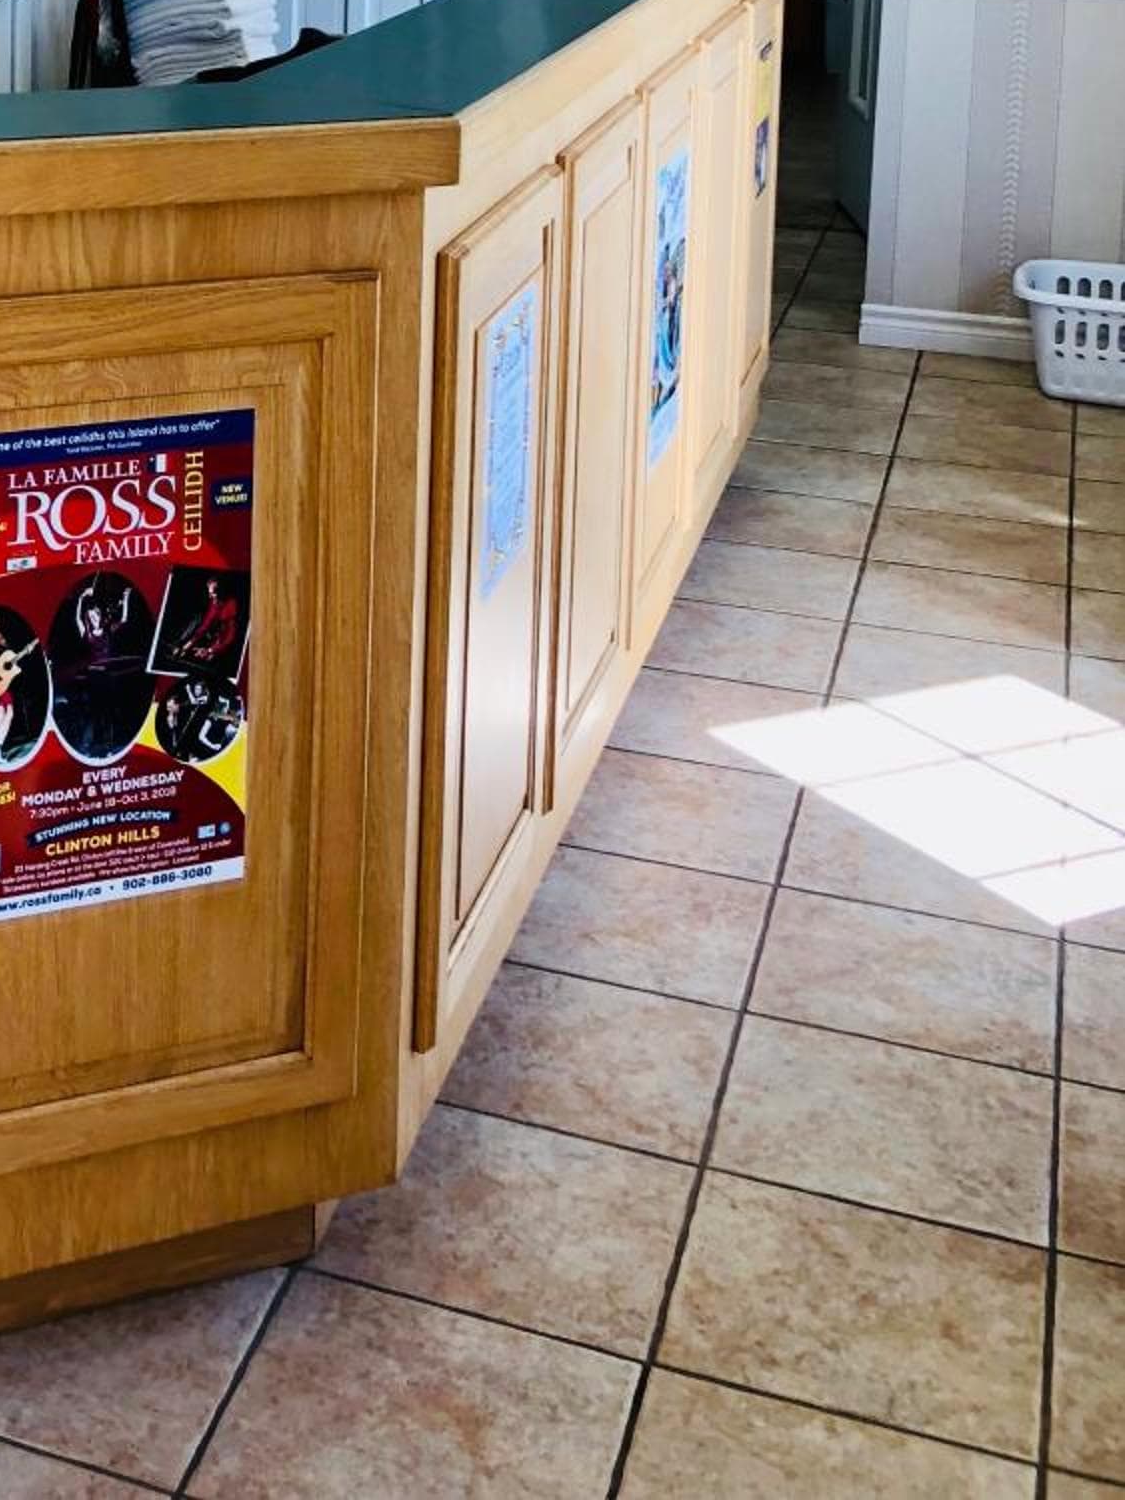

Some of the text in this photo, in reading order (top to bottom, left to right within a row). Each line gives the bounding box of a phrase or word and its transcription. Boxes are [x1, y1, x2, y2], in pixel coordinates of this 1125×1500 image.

[12, 438, 24, 451] of
[24, 437, 42, 449] the
[43, 435, 66, 447] best
[158, 423, 177, 435] has
[178, 423, 190, 433] to
[7, 459, 141, 490] LA FAMILLE
[6, 475, 177, 552] ROSS
[183, 451, 203, 551] CEILIDH
[73, 531, 175, 565] FAMILY
[20, 769, 186, 808] MONDAY & WEDNESDAY
[82, 765, 127, 785] EVERY
[76, 801, 103, 813] June
[35, 810, 172, 843] STUNNING NEW LOCATION
[45, 832, 112, 856] CLINTON
[117, 825, 161, 845] HILLS
